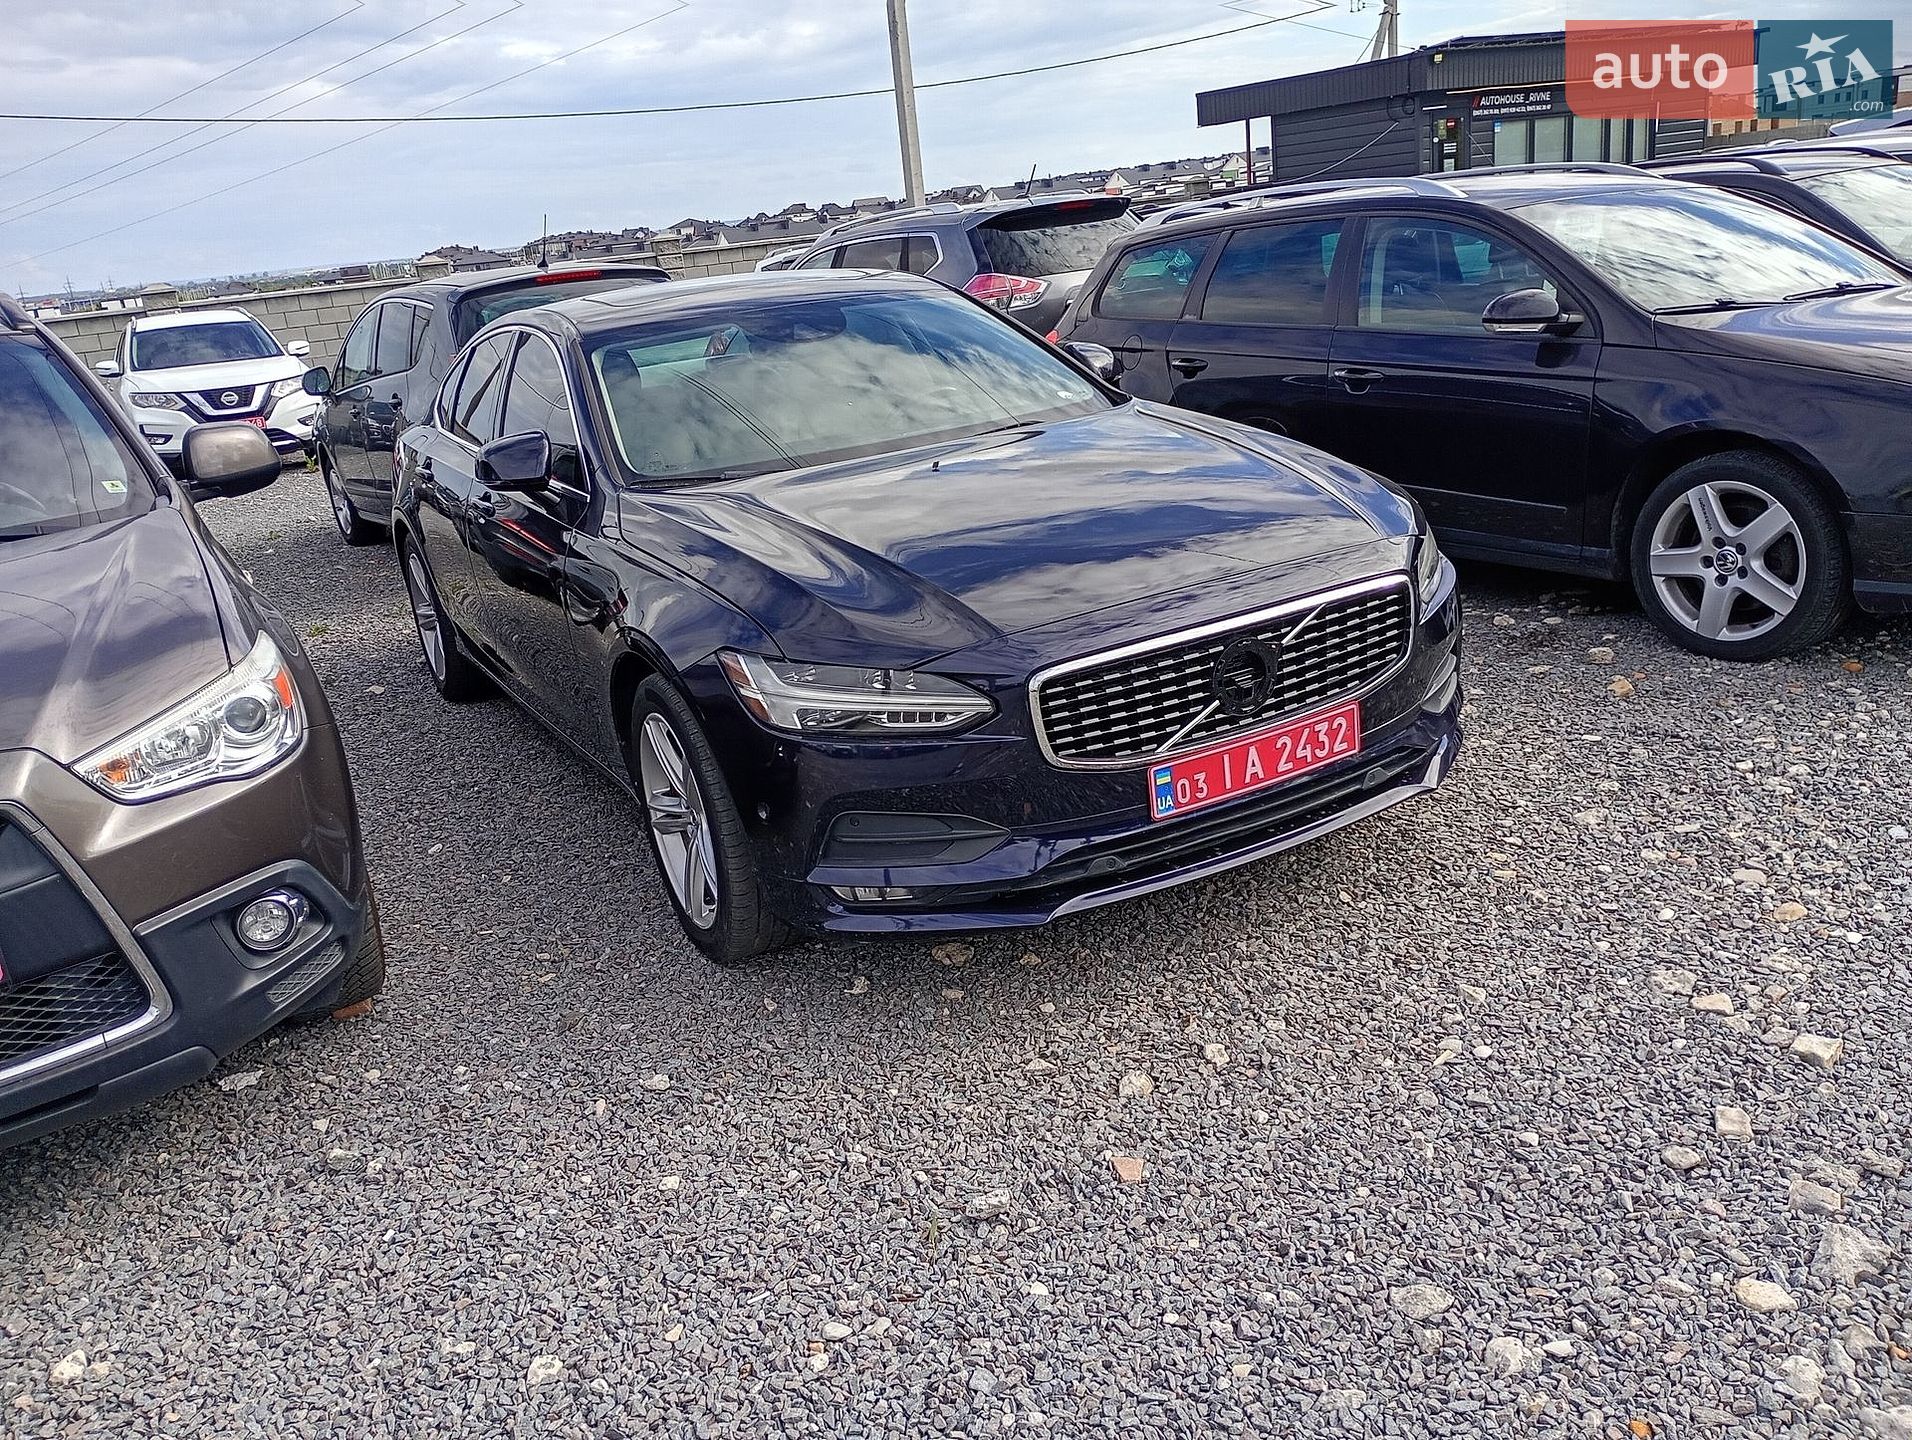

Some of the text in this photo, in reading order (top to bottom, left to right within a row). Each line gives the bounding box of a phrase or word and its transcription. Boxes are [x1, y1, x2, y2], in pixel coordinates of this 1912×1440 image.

[1176, 772, 1209, 804] 03
[1275, 716, 1349, 773] 2432
[1157, 795, 1174, 811] UA
